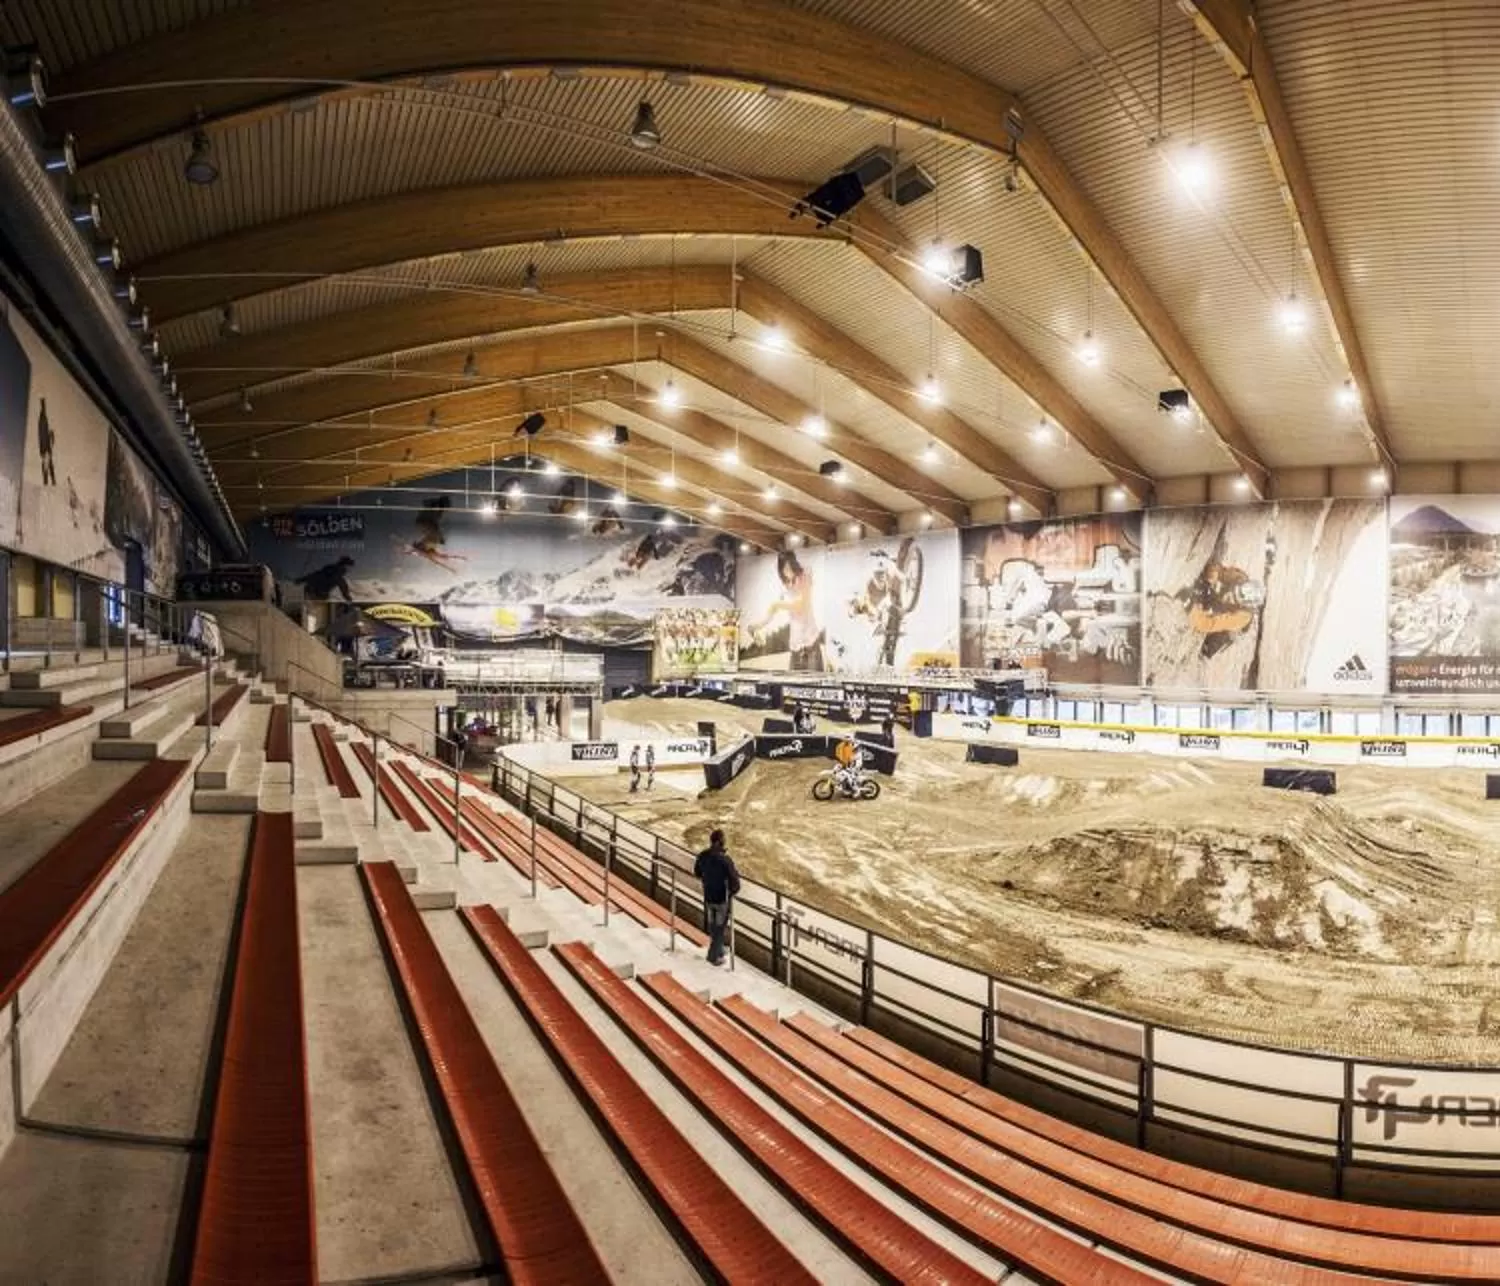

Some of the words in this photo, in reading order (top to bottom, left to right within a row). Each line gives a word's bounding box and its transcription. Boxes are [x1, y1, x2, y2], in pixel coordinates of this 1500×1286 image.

[1333, 670, 1373, 681] adidas
[1439, 664, 1477, 678] Energie
[1479, 663, 1495, 675] für
